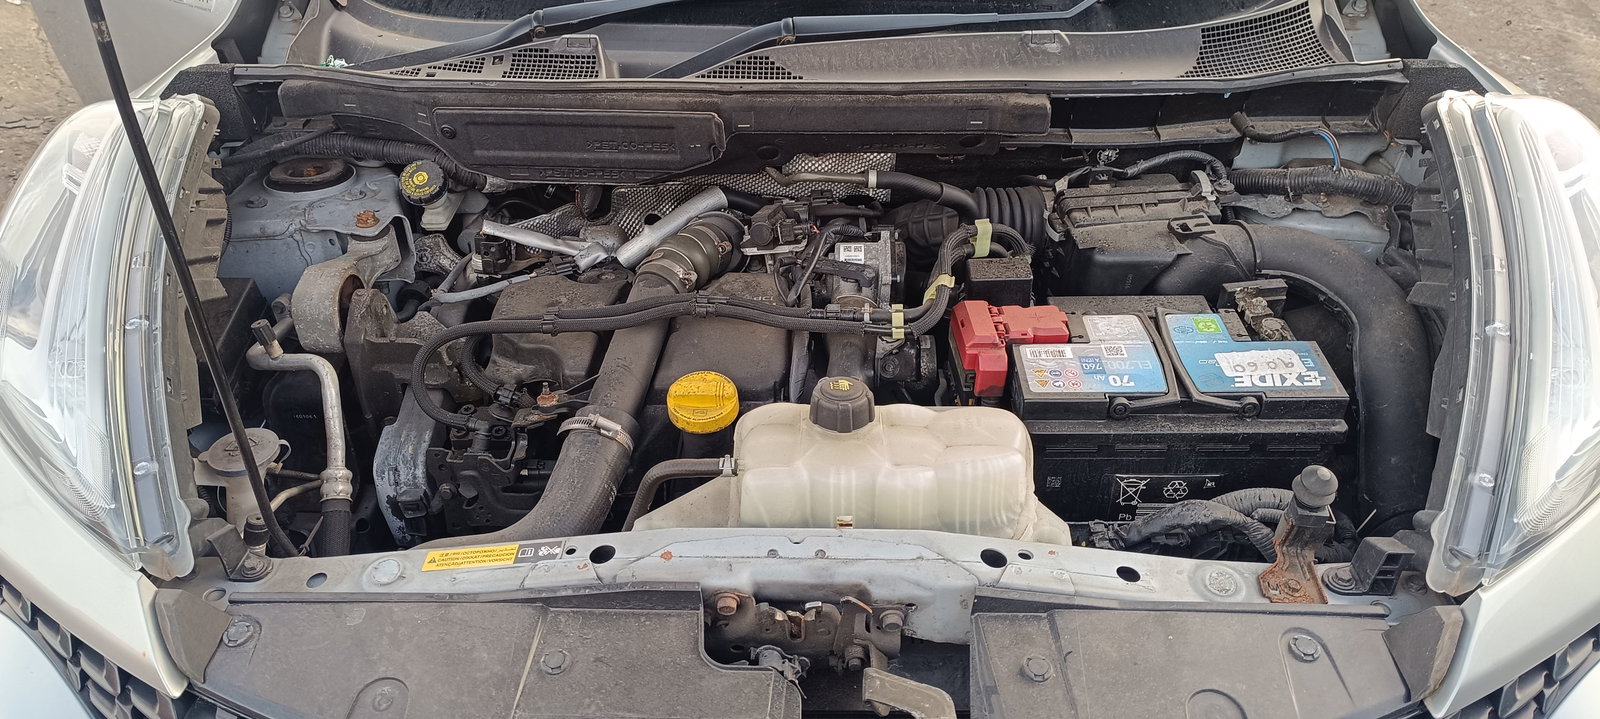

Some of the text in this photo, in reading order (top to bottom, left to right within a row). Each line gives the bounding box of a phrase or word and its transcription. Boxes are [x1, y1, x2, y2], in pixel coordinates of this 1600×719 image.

[1108, 359, 1153, 370] EL700
[1108, 375, 1137, 387] 70
[1234, 370, 1327, 388] EXIDE
[1118, 513, 1132, 521] Pb
